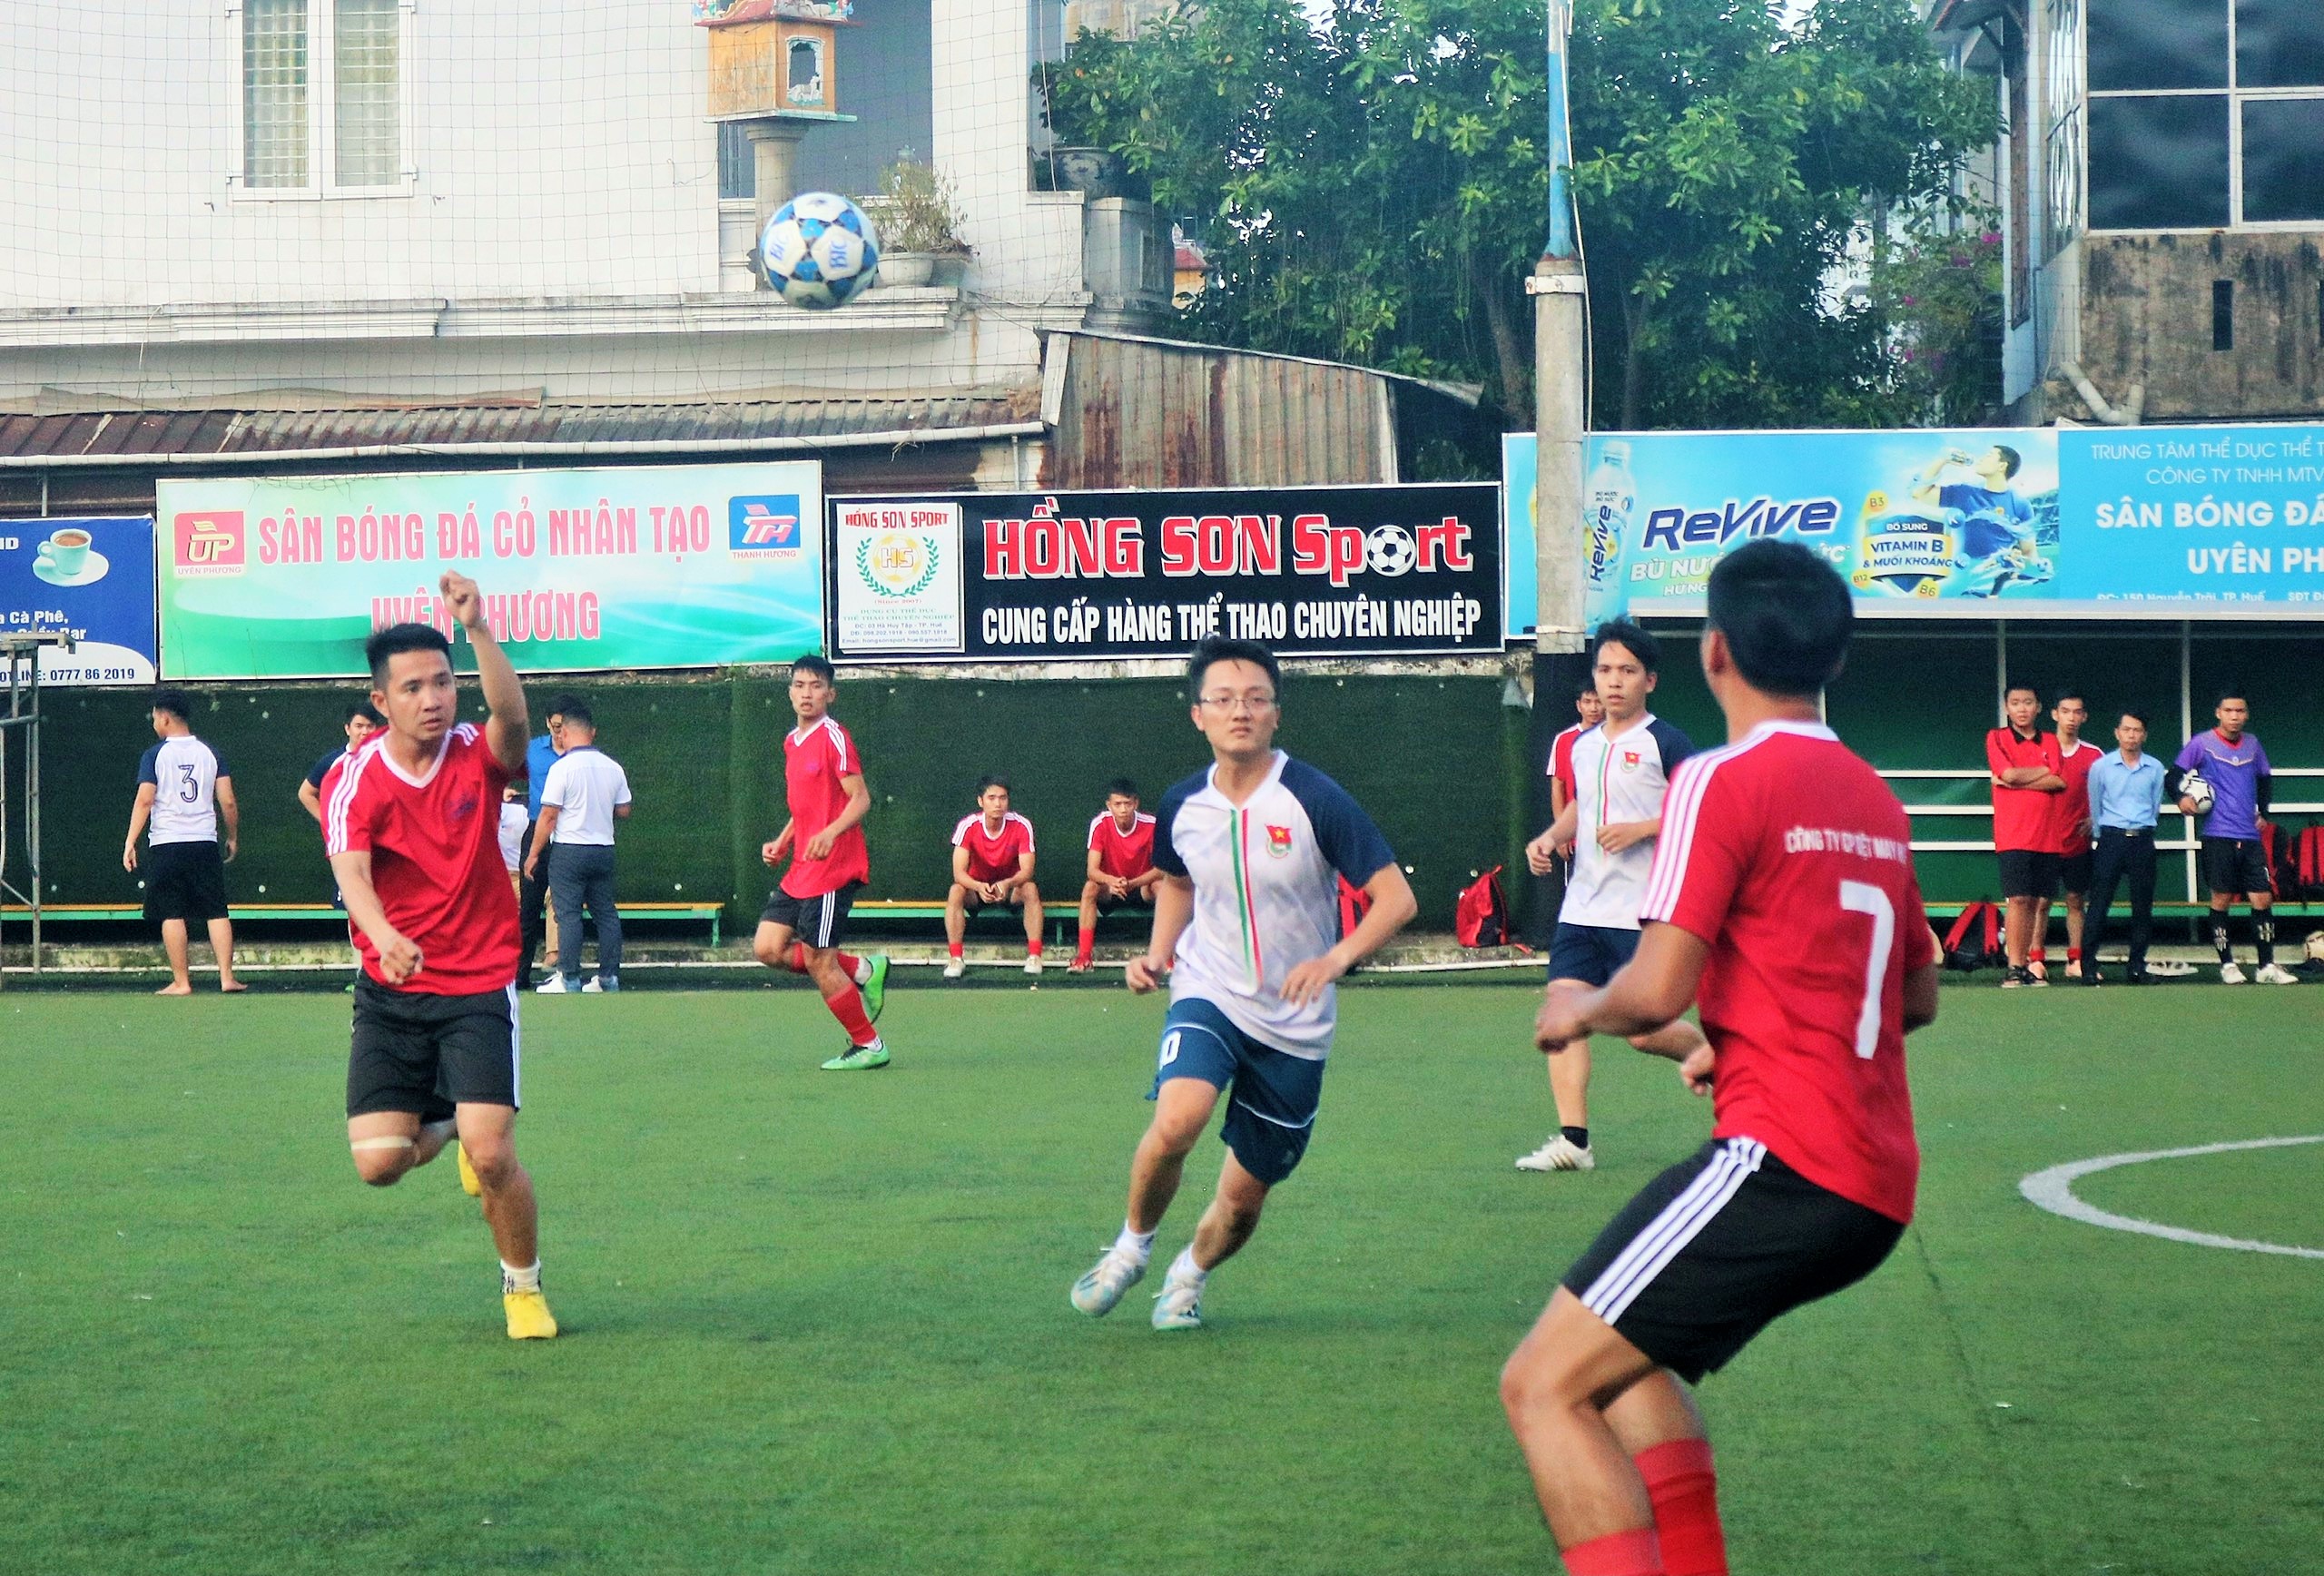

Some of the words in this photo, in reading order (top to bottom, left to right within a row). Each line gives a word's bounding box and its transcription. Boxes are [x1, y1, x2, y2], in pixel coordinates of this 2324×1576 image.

[2091, 443, 2152, 459] TRUNG
[2157, 440, 2195, 458] TÂM
[2200, 436, 2230, 458] THỂ
[2236, 442, 2276, 460] DỤC
[2281, 435, 2311, 458] THỂ
[2146, 466, 2206, 484] CÔNG
[2211, 468, 2231, 483] TY
[2237, 468, 2282, 483] TNHH
[911, 511, 950, 528] SPORT
[2095, 495, 2162, 528] SÂN
[2174, 493, 2274, 527] BÓNG
[258, 507, 323, 565] SÂN
[336, 505, 425, 563] BÓNG
[436, 501, 481, 560] ĐÁ
[492, 496, 537, 558] CỎ
[548, 497, 637, 557] NHÂN
[649, 504, 711, 563] TẠO
[1901, 523, 1928, 531] SUNG
[982, 496, 1145, 580] HỒNG
[1870, 541, 1927, 553] VITAMIN
[1932, 539, 1944, 552] B
[733, 551, 762, 559] THANH
[763, 550, 796, 558] HƯƠNG
[881, 547, 914, 568] HS
[1863, 560, 1870, 568] &
[2187, 541, 2271, 574] UYÊN
[2282, 547, 2324, 574] PH
[178, 566, 201, 575] UYÊN
[1630, 557, 1666, 582] BÙ
[1669, 551, 1726, 578] NƯỚ
[1919, 584, 1936, 596] B6
[9, 611, 30, 625] Cà
[34, 609, 69, 624] Phê,
[466, 589, 600, 643] HƯƠNG
[981, 606, 1047, 645] CUNG
[1053, 596, 1100, 644] CẤP
[1107, 596, 1172, 643] HÀNG
[1177, 591, 1224, 641] THỂ
[1226, 601, 1287, 640] THAO
[1294, 593, 1390, 640] CHUYÊN
[1393, 591, 1482, 643] NGHIỆP
[50, 669, 80, 681] 0777
[85, 668, 100, 680] 86
[104, 668, 134, 680] 2019
[178, 763, 198, 803] 3
[1839, 879, 1896, 1059] 7
